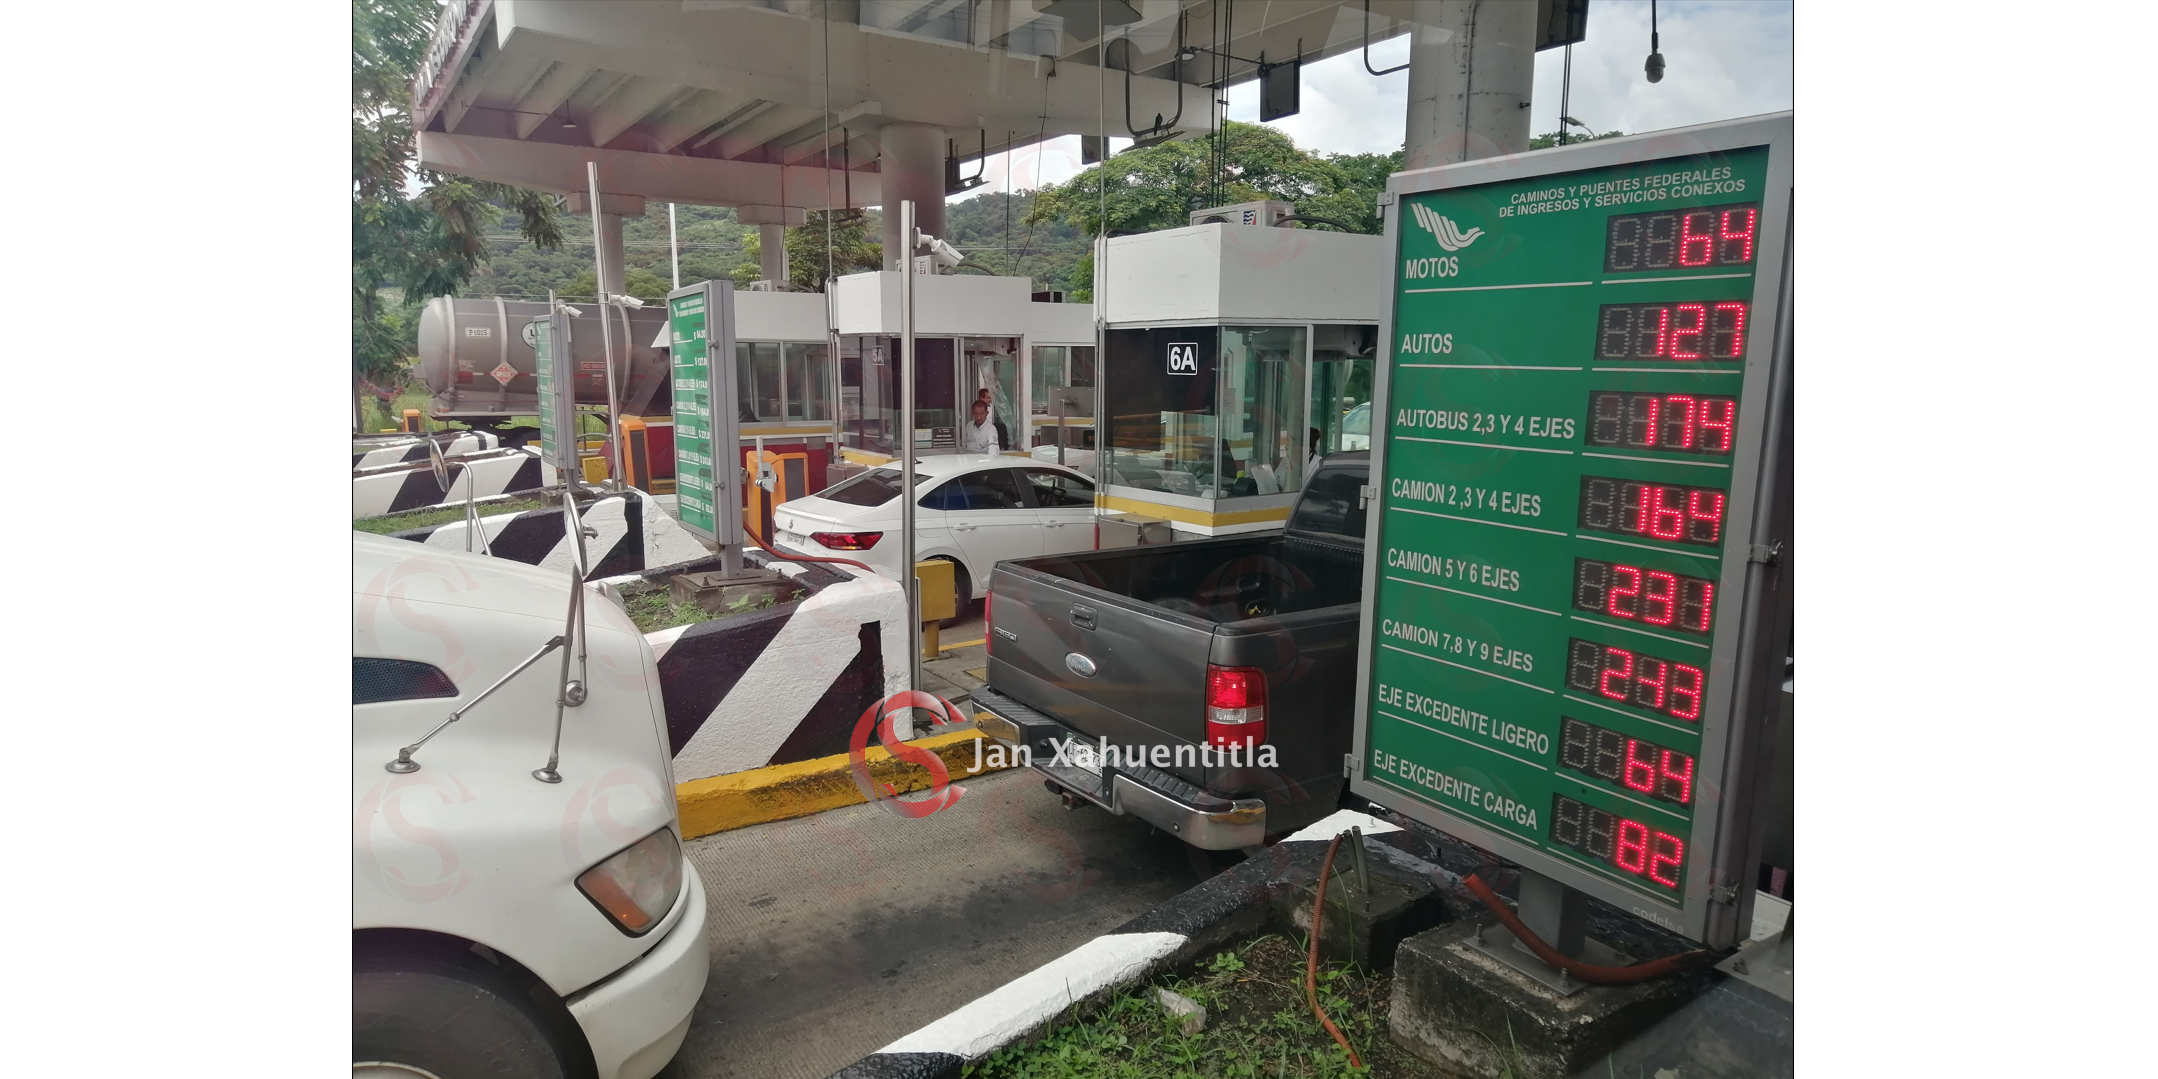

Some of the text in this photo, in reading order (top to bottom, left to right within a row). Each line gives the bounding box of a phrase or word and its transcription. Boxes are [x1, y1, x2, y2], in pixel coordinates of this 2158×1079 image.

[1499, 179, 1746, 218] DE INGRESOS Y SERVICIOS CONEXOS
[1511, 166, 1732, 205] CAMINOS Y PUENTES FEDERALES
[1678, 208, 1757, 267] 64
[1405, 256, 1459, 279] MOTOS
[872, 348, 884, 363] 5A
[1401, 332, 1453, 355] AUTOS
[1654, 302, 1747, 359] 127
[1170, 346, 1196, 371] 6A
[1396, 409, 1576, 440] AUTOBUS 2,3 Y 4 EJES
[1645, 395, 1736, 452] 174
[1391, 477, 1446, 505] CAMION
[1448, 485, 1456, 505] 2
[1475, 489, 1487, 509] Y
[1488, 490, 1498, 511] 4
[1502, 491, 1542, 518] EJES
[1636, 485, 1726, 543] 164
[1387, 548, 1520, 592] CAMION 5 Y 6 EJES
[1607, 564, 1714, 632] 231
[1382, 618, 1534, 673] CAMION 7,8 Y 9 EJES
[1600, 646, 1704, 721] 243
[1378, 684, 1550, 756] EJE EXCEDENTE LIGERO
[1373, 749, 1538, 831] EJE EXCEDENTE CARGA
[1624, 738, 1695, 804] 64
[1615, 818, 1684, 888] 82
[1632, 906, 1684, 935] codelsa
